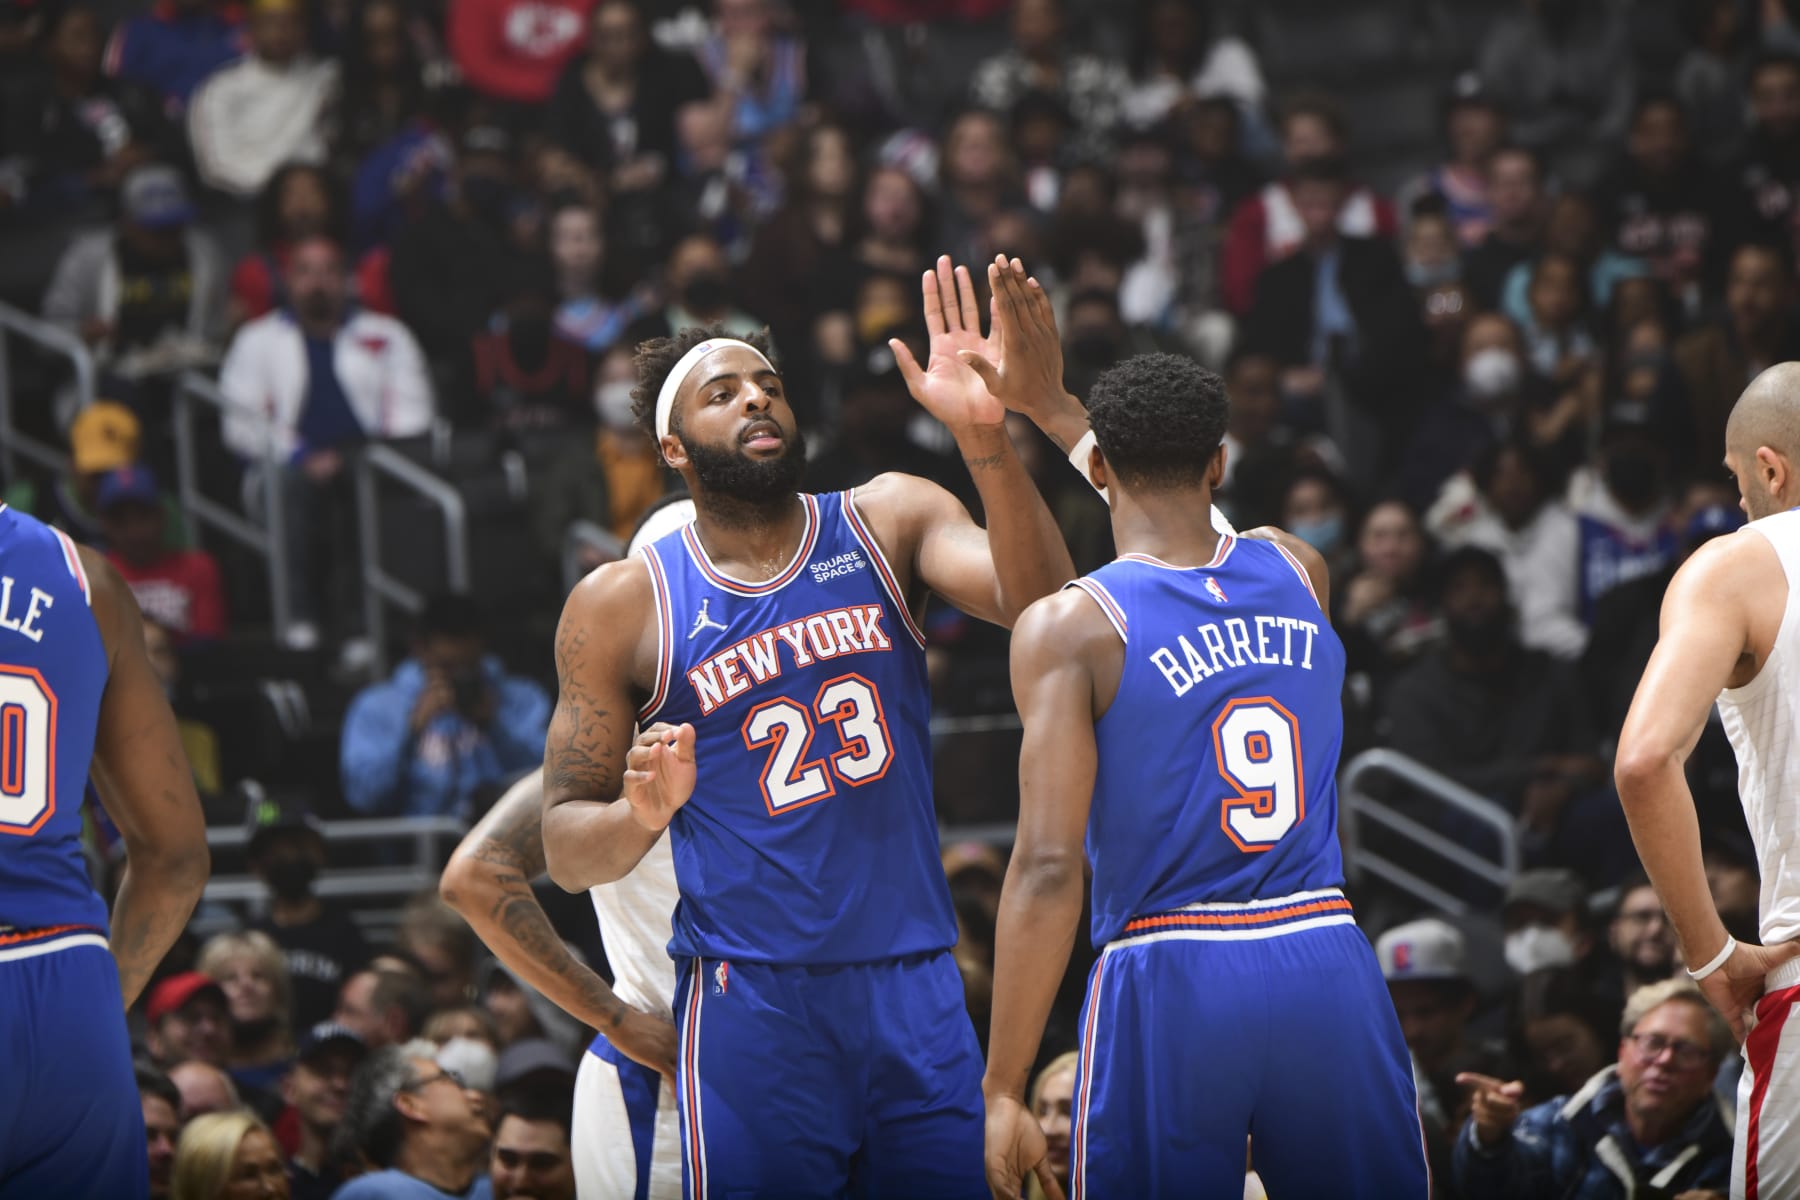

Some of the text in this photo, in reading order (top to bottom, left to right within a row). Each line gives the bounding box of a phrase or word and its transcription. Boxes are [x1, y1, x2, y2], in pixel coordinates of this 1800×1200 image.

[810, 551, 860, 573] SQUARE
[814, 563, 855, 583] SPACE
[687, 604, 892, 717] NEW YORK
[1150, 616, 1319, 697] BARRETT
[741, 672, 895, 816] 23
[1212, 696, 1305, 853] 9
